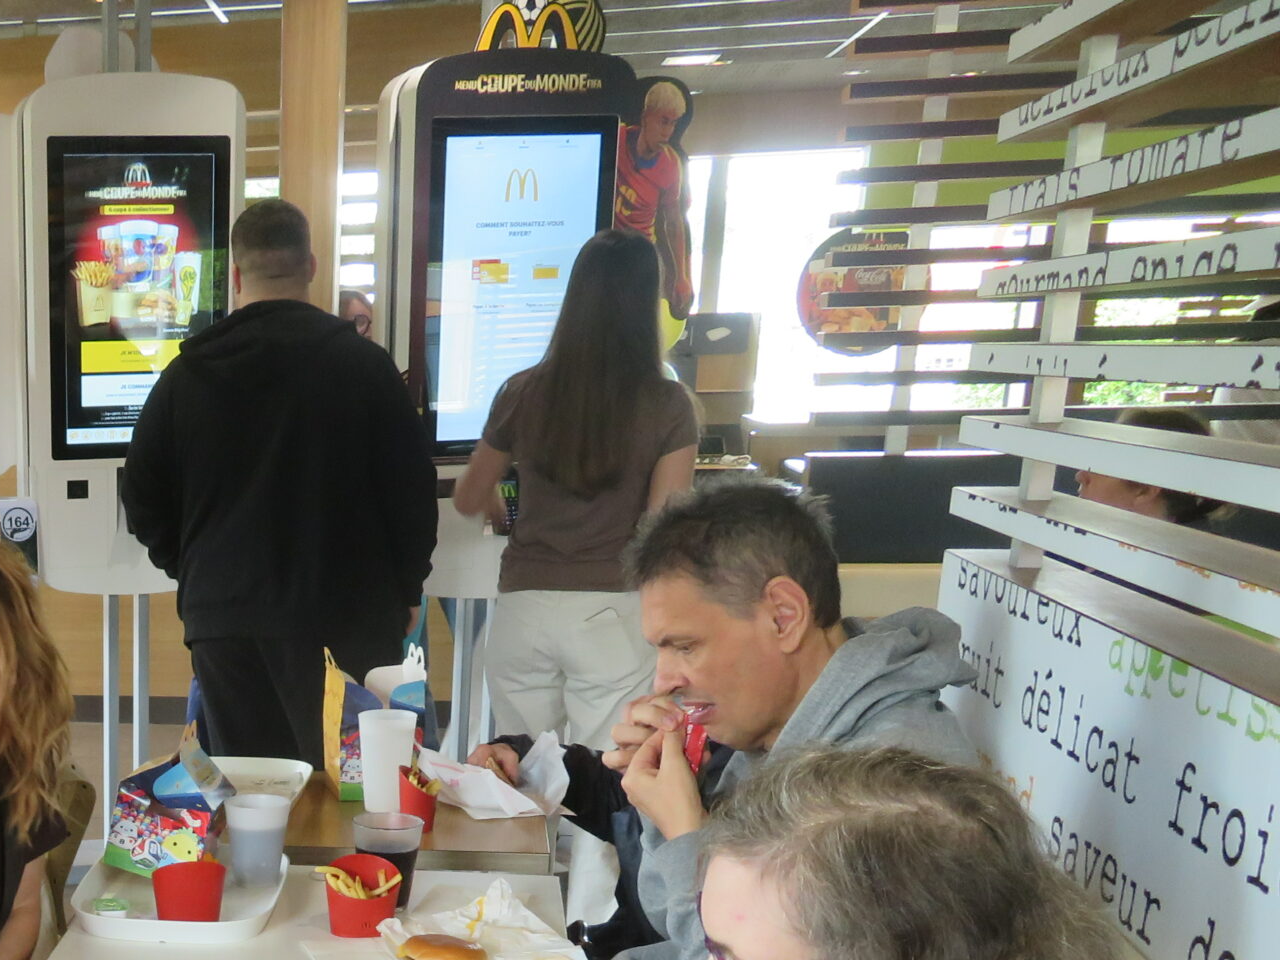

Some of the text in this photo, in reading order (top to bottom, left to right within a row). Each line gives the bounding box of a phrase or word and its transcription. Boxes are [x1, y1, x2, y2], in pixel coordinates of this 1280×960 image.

[455, 74, 602, 93] MENU COUPE DU MONDE FIFA
[8, 516, 30, 528] 164
[1021, 668, 1140, 804] délicat
[1168, 762, 1280, 894] froi
[1050, 816, 1161, 946] saveur
